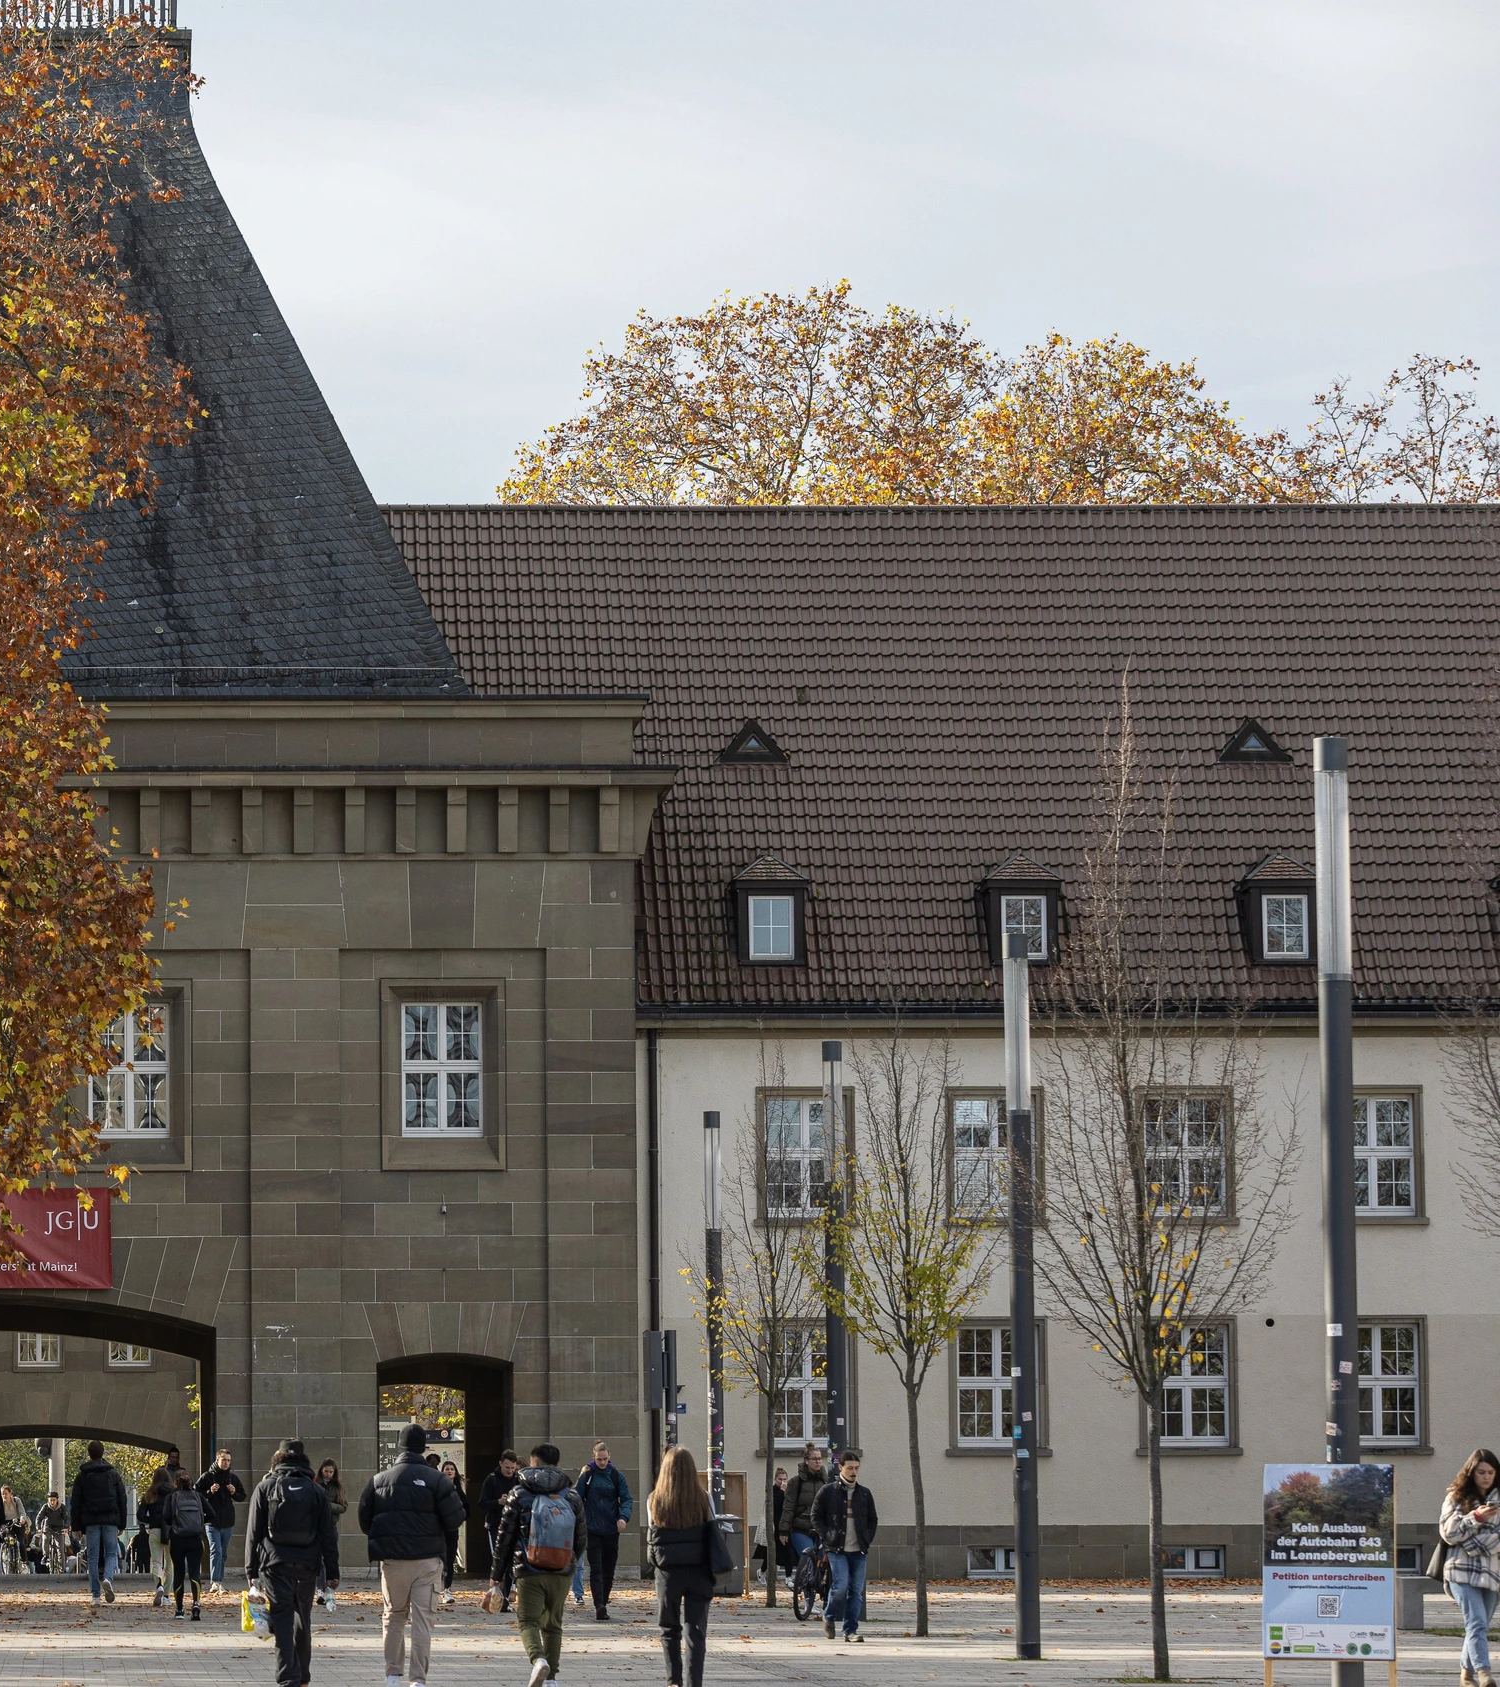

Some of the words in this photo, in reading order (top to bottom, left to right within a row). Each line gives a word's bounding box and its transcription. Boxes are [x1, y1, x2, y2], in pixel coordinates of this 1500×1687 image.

[39, 1261, 78, 1273] Mainz!
[1291, 1522, 1319, 1533] Kein
[1321, 1523, 1366, 1533] Ausbau
[1277, 1536, 1298, 1546] der
[1299, 1536, 1357, 1547] Autobahn
[1359, 1537, 1382, 1547] 643
[1270, 1549, 1287, 1560] im
[1290, 1550, 1388, 1563] Lennebergwald
[1272, 1572, 1310, 1581] Petition
[1312, 1573, 1386, 1582] unterschreiben
